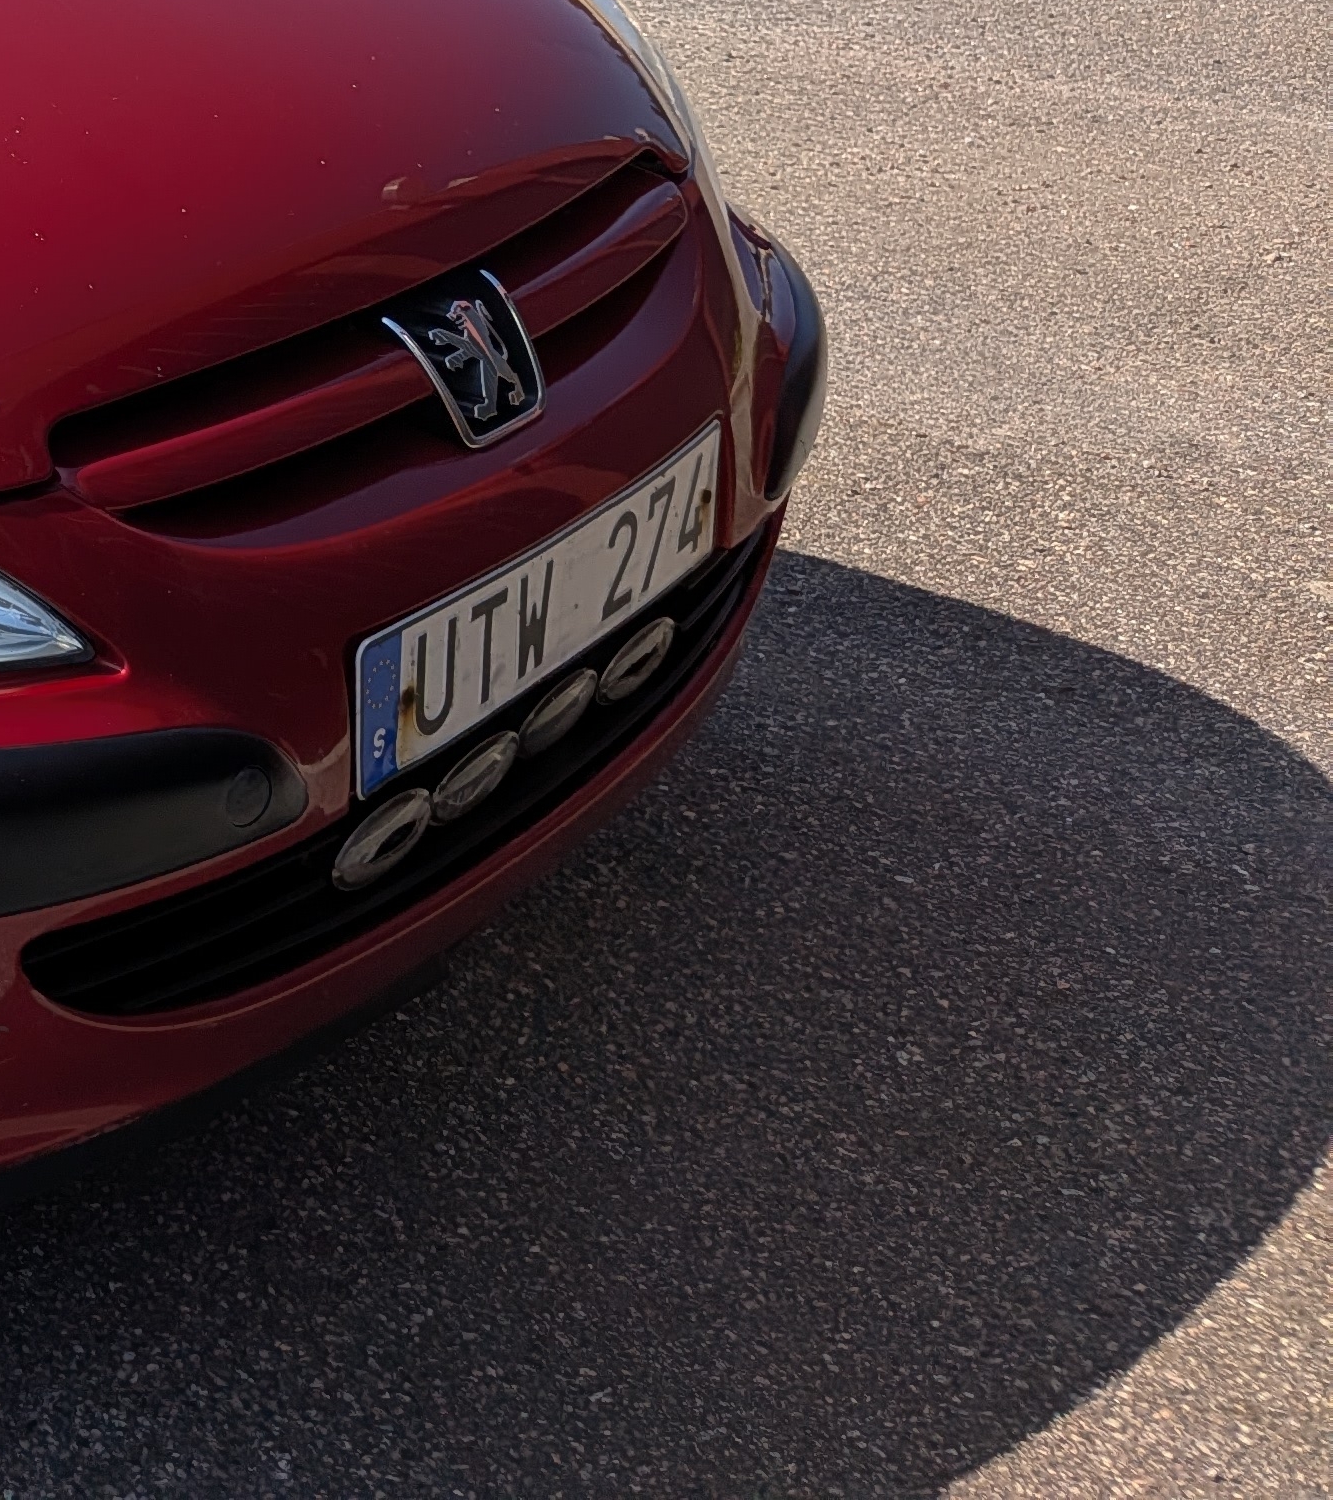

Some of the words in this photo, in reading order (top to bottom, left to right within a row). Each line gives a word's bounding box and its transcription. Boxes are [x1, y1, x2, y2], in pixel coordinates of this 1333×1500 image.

[415, 559, 554, 736] UTW
[601, 452, 710, 622] 274
[373, 727, 386, 759] S
